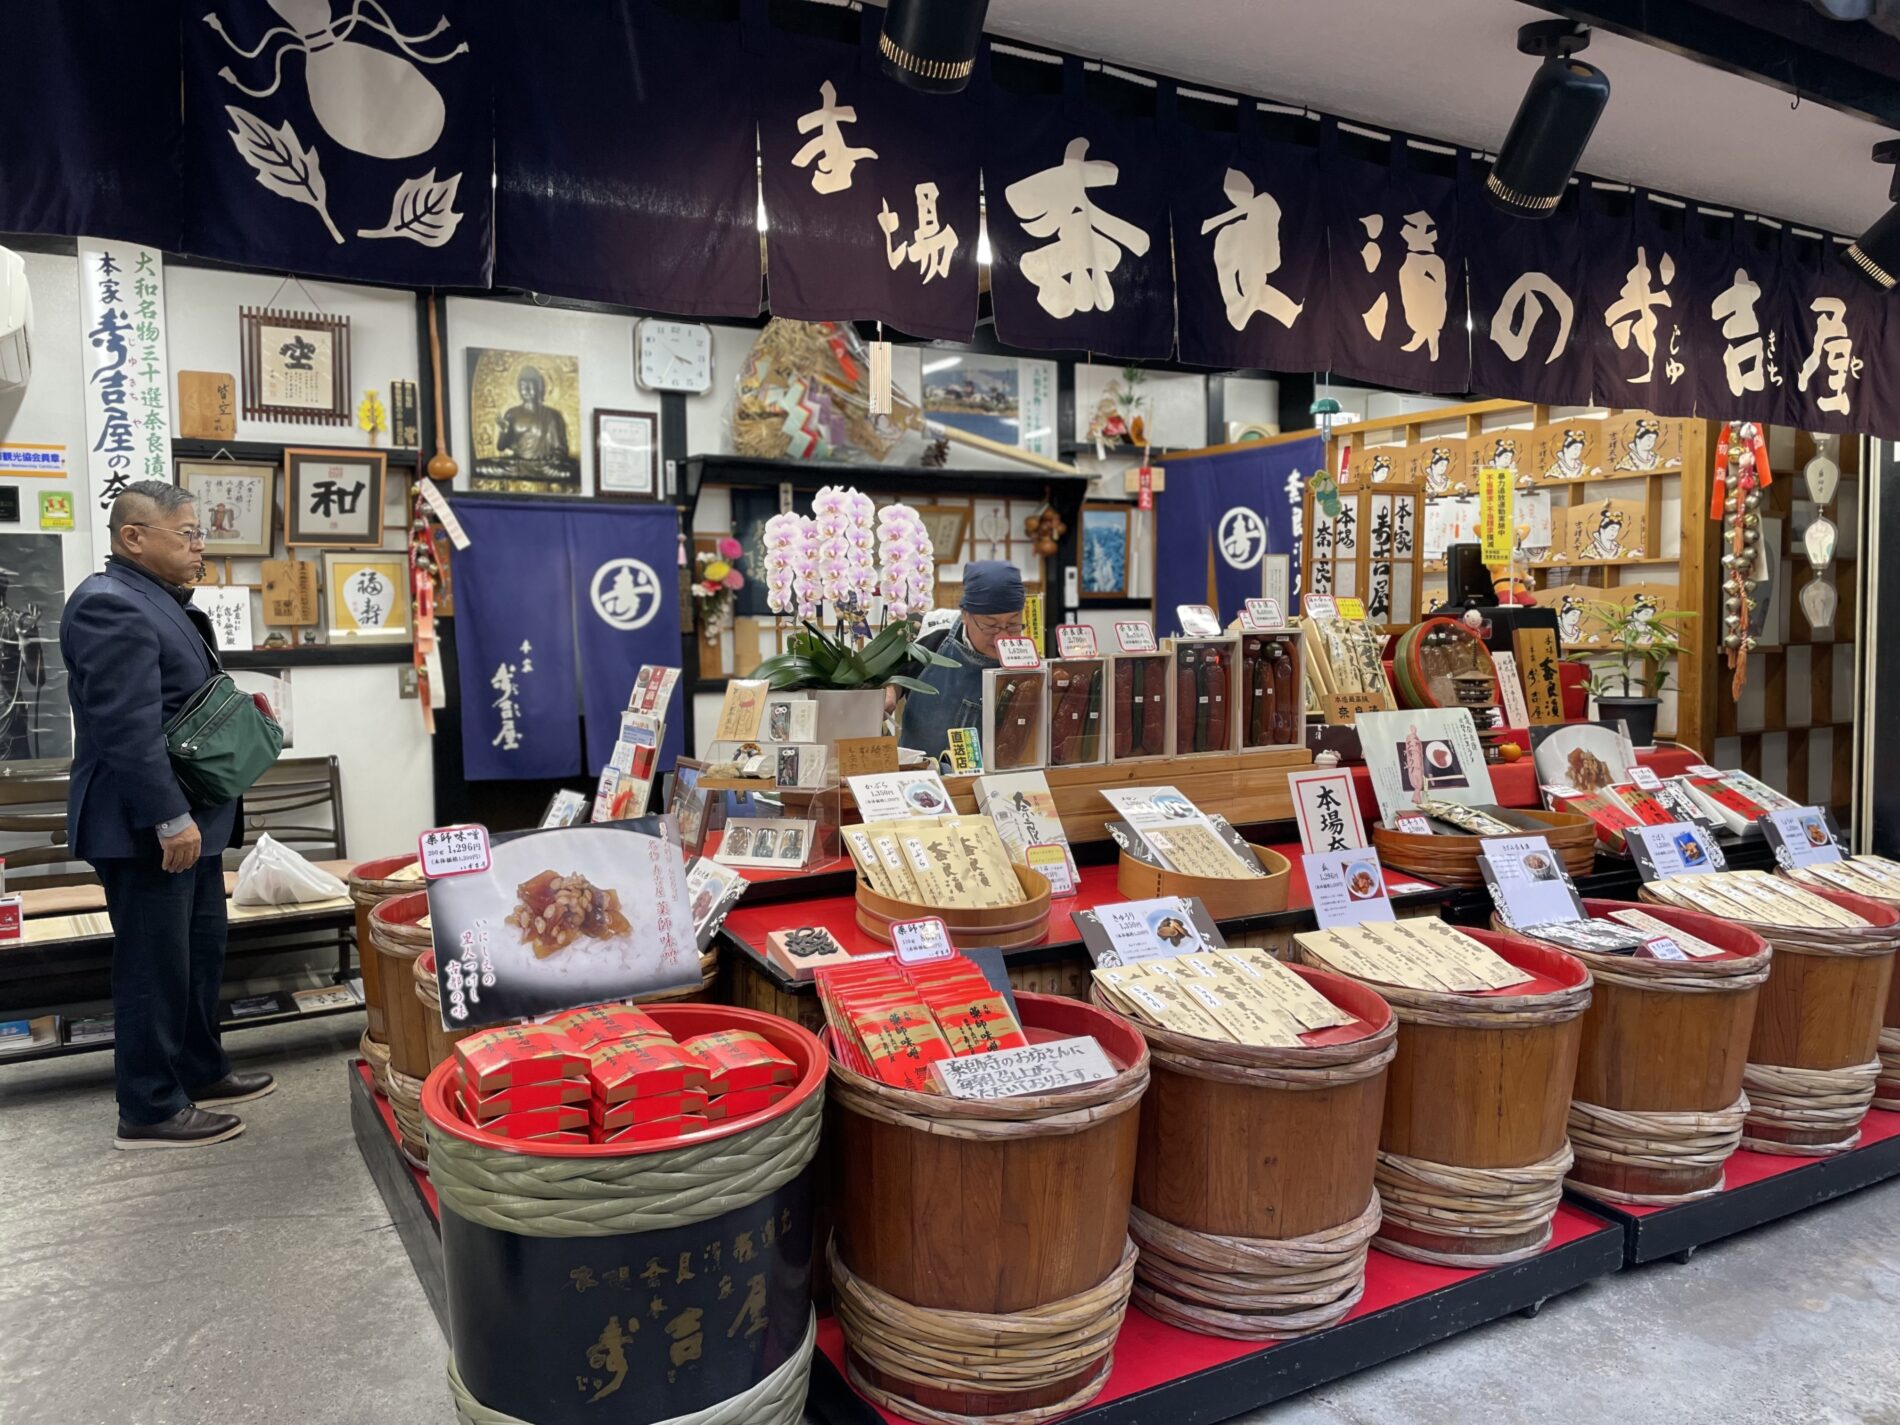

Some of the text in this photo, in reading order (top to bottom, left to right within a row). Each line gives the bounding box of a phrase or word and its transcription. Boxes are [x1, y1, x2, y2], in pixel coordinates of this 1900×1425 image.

[134, 251, 167, 478] 大和名物三十選奈良漬
[1849, 356, 1863, 380] や
[0, 451, 60, 463] 観光協会員章
[310, 479, 366, 518] 和
[1336, 503, 1356, 549] 本場
[1395, 498, 1412, 553] 本家
[927, 618, 950, 628] BLK
[426, 829, 480, 845] 薬師味噌
[448, 842, 481, 854] 1,296円
[475, 919, 494, 986] いにしえの
[656, 901, 678, 965] 薬師味噌
[889, 1012, 919, 1060] 薬師味噌
[970, 1006, 999, 1052] 薬師味噌
[946, 1044, 1086, 1079] 薬師寺のお坊さんに
